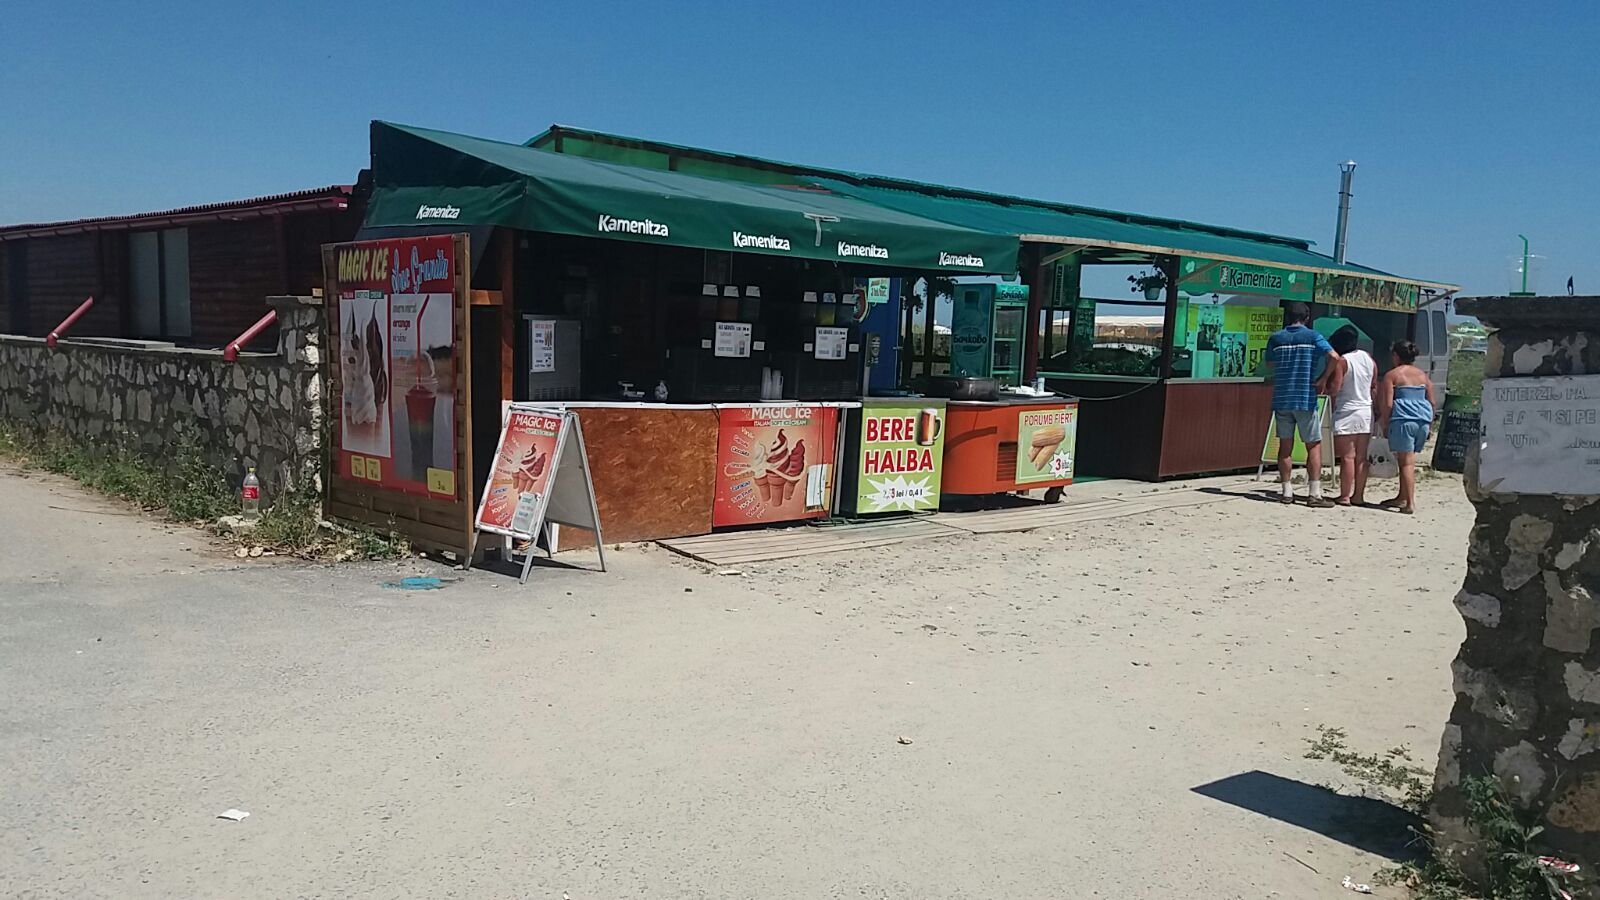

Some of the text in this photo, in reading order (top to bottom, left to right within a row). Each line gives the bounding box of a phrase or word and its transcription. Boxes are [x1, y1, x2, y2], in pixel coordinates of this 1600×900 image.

[416, 204, 460, 220] Kamenitza
[598, 214, 669, 237] Kamenitza
[732, 231, 791, 251] Kamenitza
[837, 241, 889, 259] Kamenitza
[339, 247, 389, 282] MAGIC ICE
[938, 251, 984, 268] Kamenitza
[1228, 266, 1282, 290] Kamenitza
[515, 414, 557, 431] MAGIC Ice
[752, 407, 793, 420] MAGIC
[1024, 412, 1073, 426] PORUMB FIERT
[865, 417, 915, 442] BERE
[864, 448, 934, 475] HALBA
[1055, 458, 1062, 471] 3
